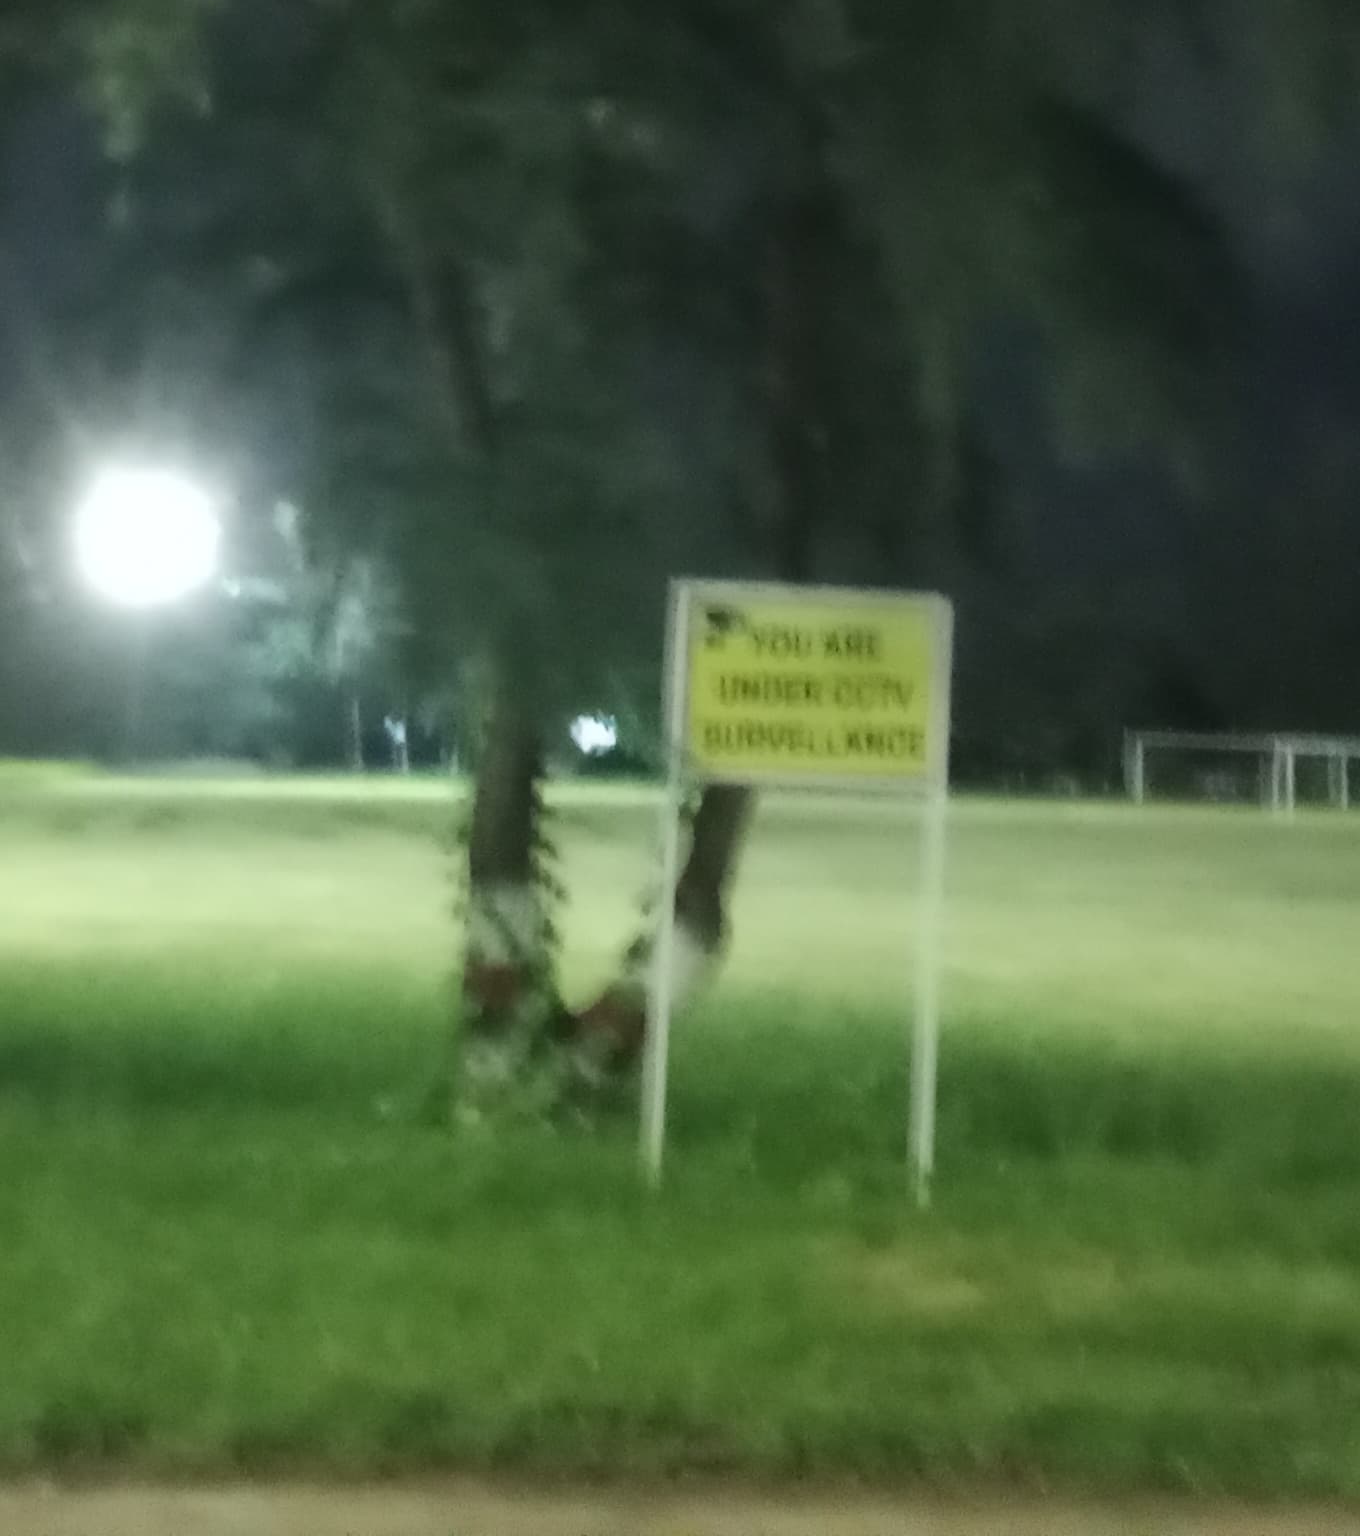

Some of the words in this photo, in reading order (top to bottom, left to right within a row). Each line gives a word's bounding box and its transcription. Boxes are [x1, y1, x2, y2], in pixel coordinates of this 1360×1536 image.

[752, 626, 813, 658] YOU
[822, 626, 881, 660] ARE
[719, 672, 822, 706] UNDER
[831, 675, 913, 711] CCTV
